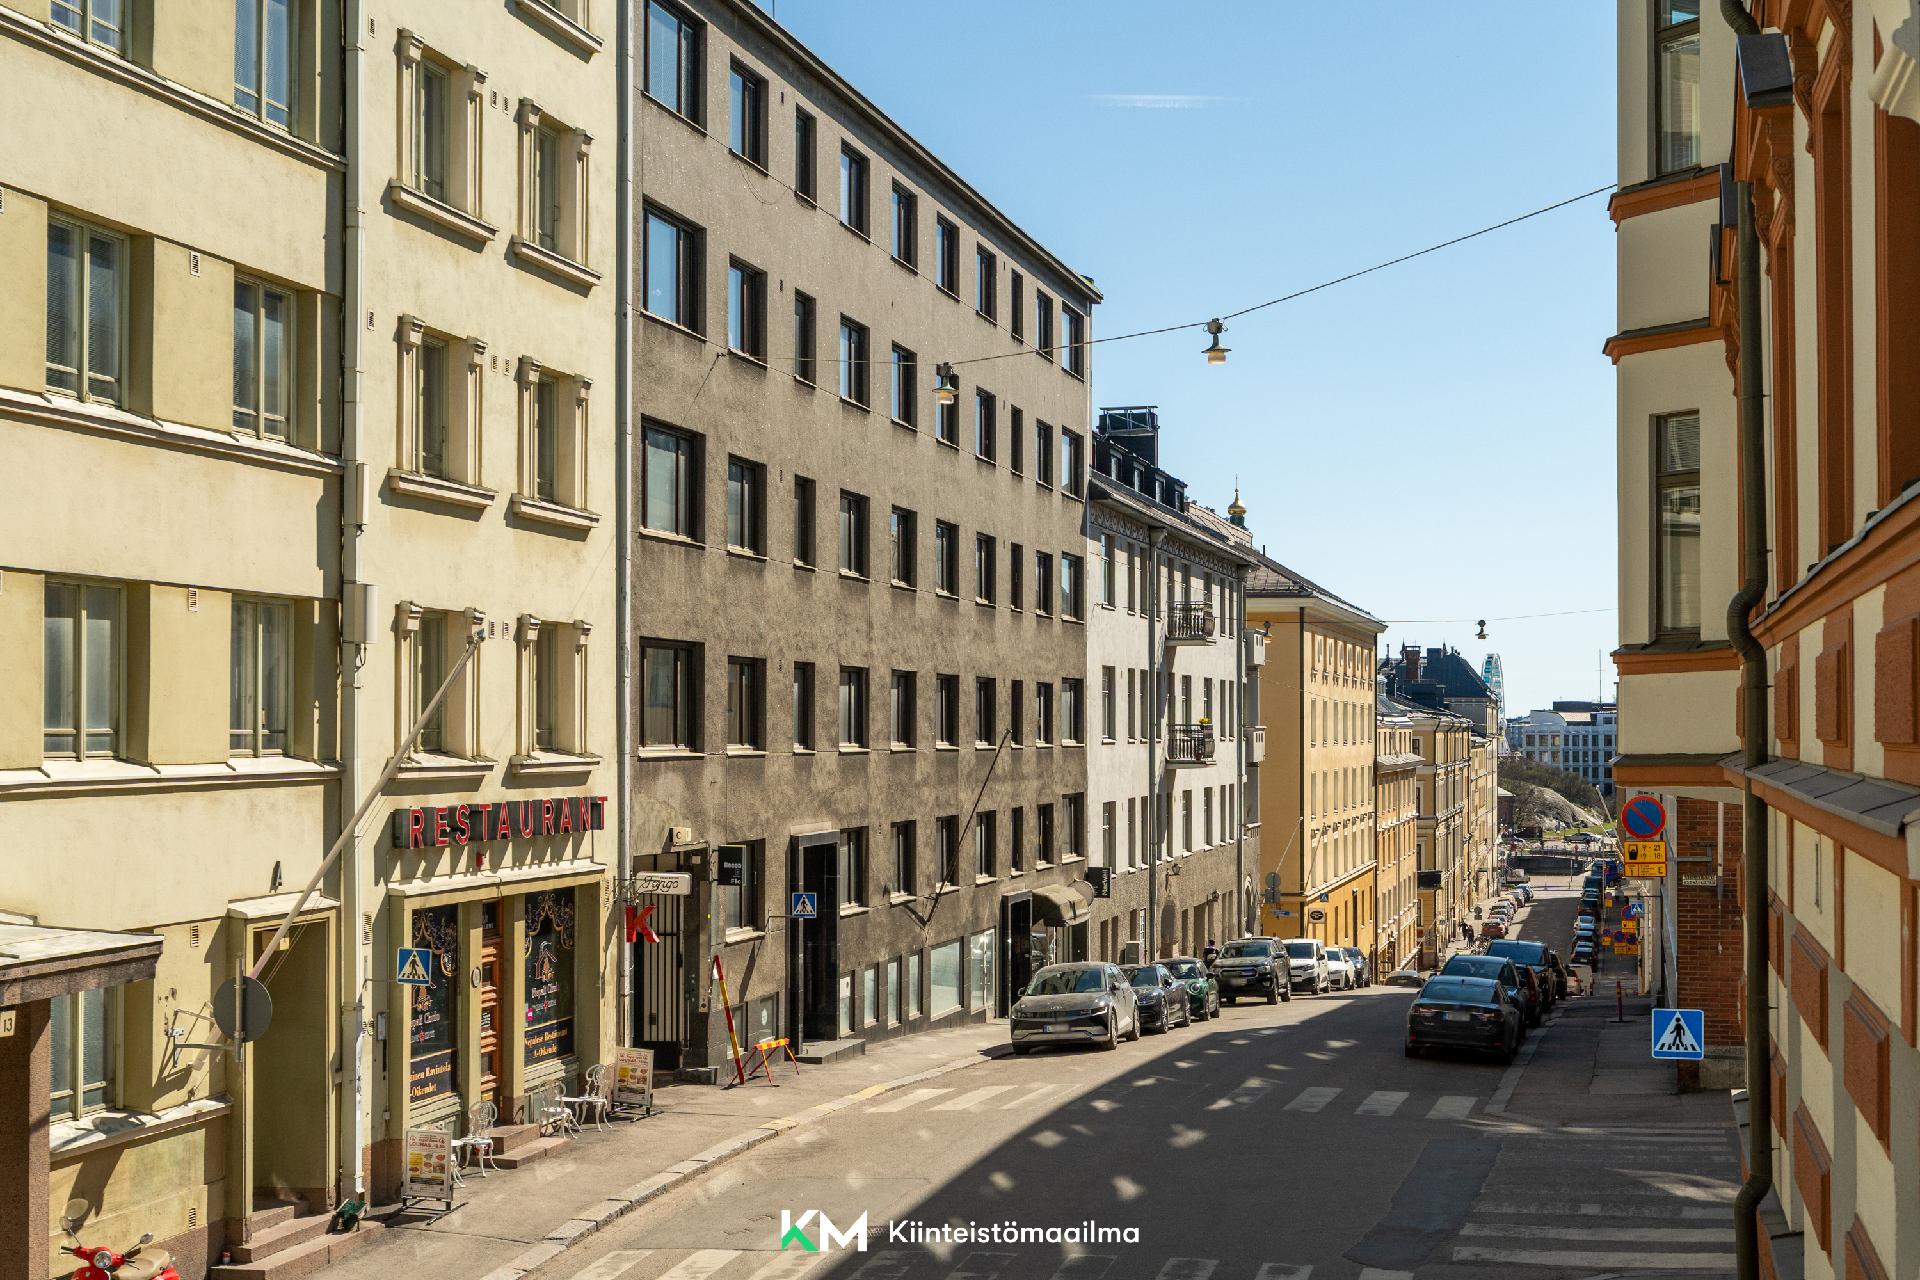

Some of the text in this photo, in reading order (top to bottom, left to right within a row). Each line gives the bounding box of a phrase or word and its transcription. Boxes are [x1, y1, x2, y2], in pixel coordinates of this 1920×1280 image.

[410, 796, 608, 849] RESTAURANT
[625, 903, 660, 942] K
[3, 1017, 13, 1033] 13
